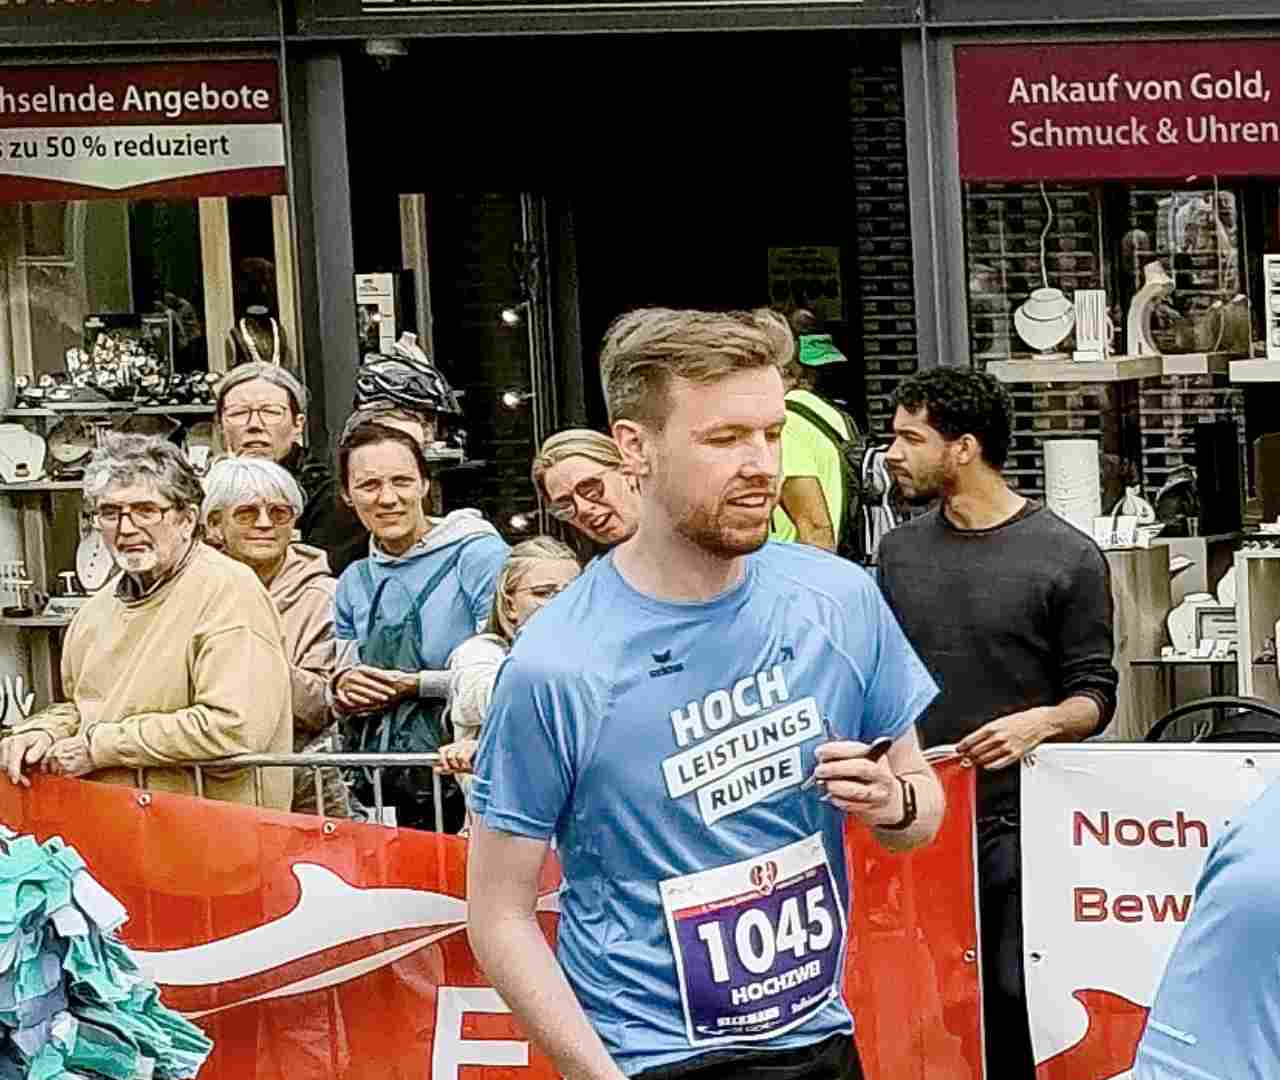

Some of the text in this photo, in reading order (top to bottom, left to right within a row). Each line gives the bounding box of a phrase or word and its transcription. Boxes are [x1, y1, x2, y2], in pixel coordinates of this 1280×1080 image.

[122, 82, 269, 117] Angebote
[1008, 70, 1271, 103] Ankauf von Gold,
[10, 141, 37, 158] zu
[46, 136, 75, 157] 50
[83, 136, 105, 156] %
[115, 134, 229, 156] reduziert
[1011, 115, 1279, 147] Schmuck & Uhren
[671, 664, 789, 748] HOCH
[678, 709, 810, 785] LEISTUNGS
[711, 758, 793, 810] RUNDE
[1073, 811, 1208, 848] Noch
[1073, 887, 1192, 922] Bew
[697, 885, 833, 983] 1045
[731, 959, 820, 1005] HOCHZWEI
